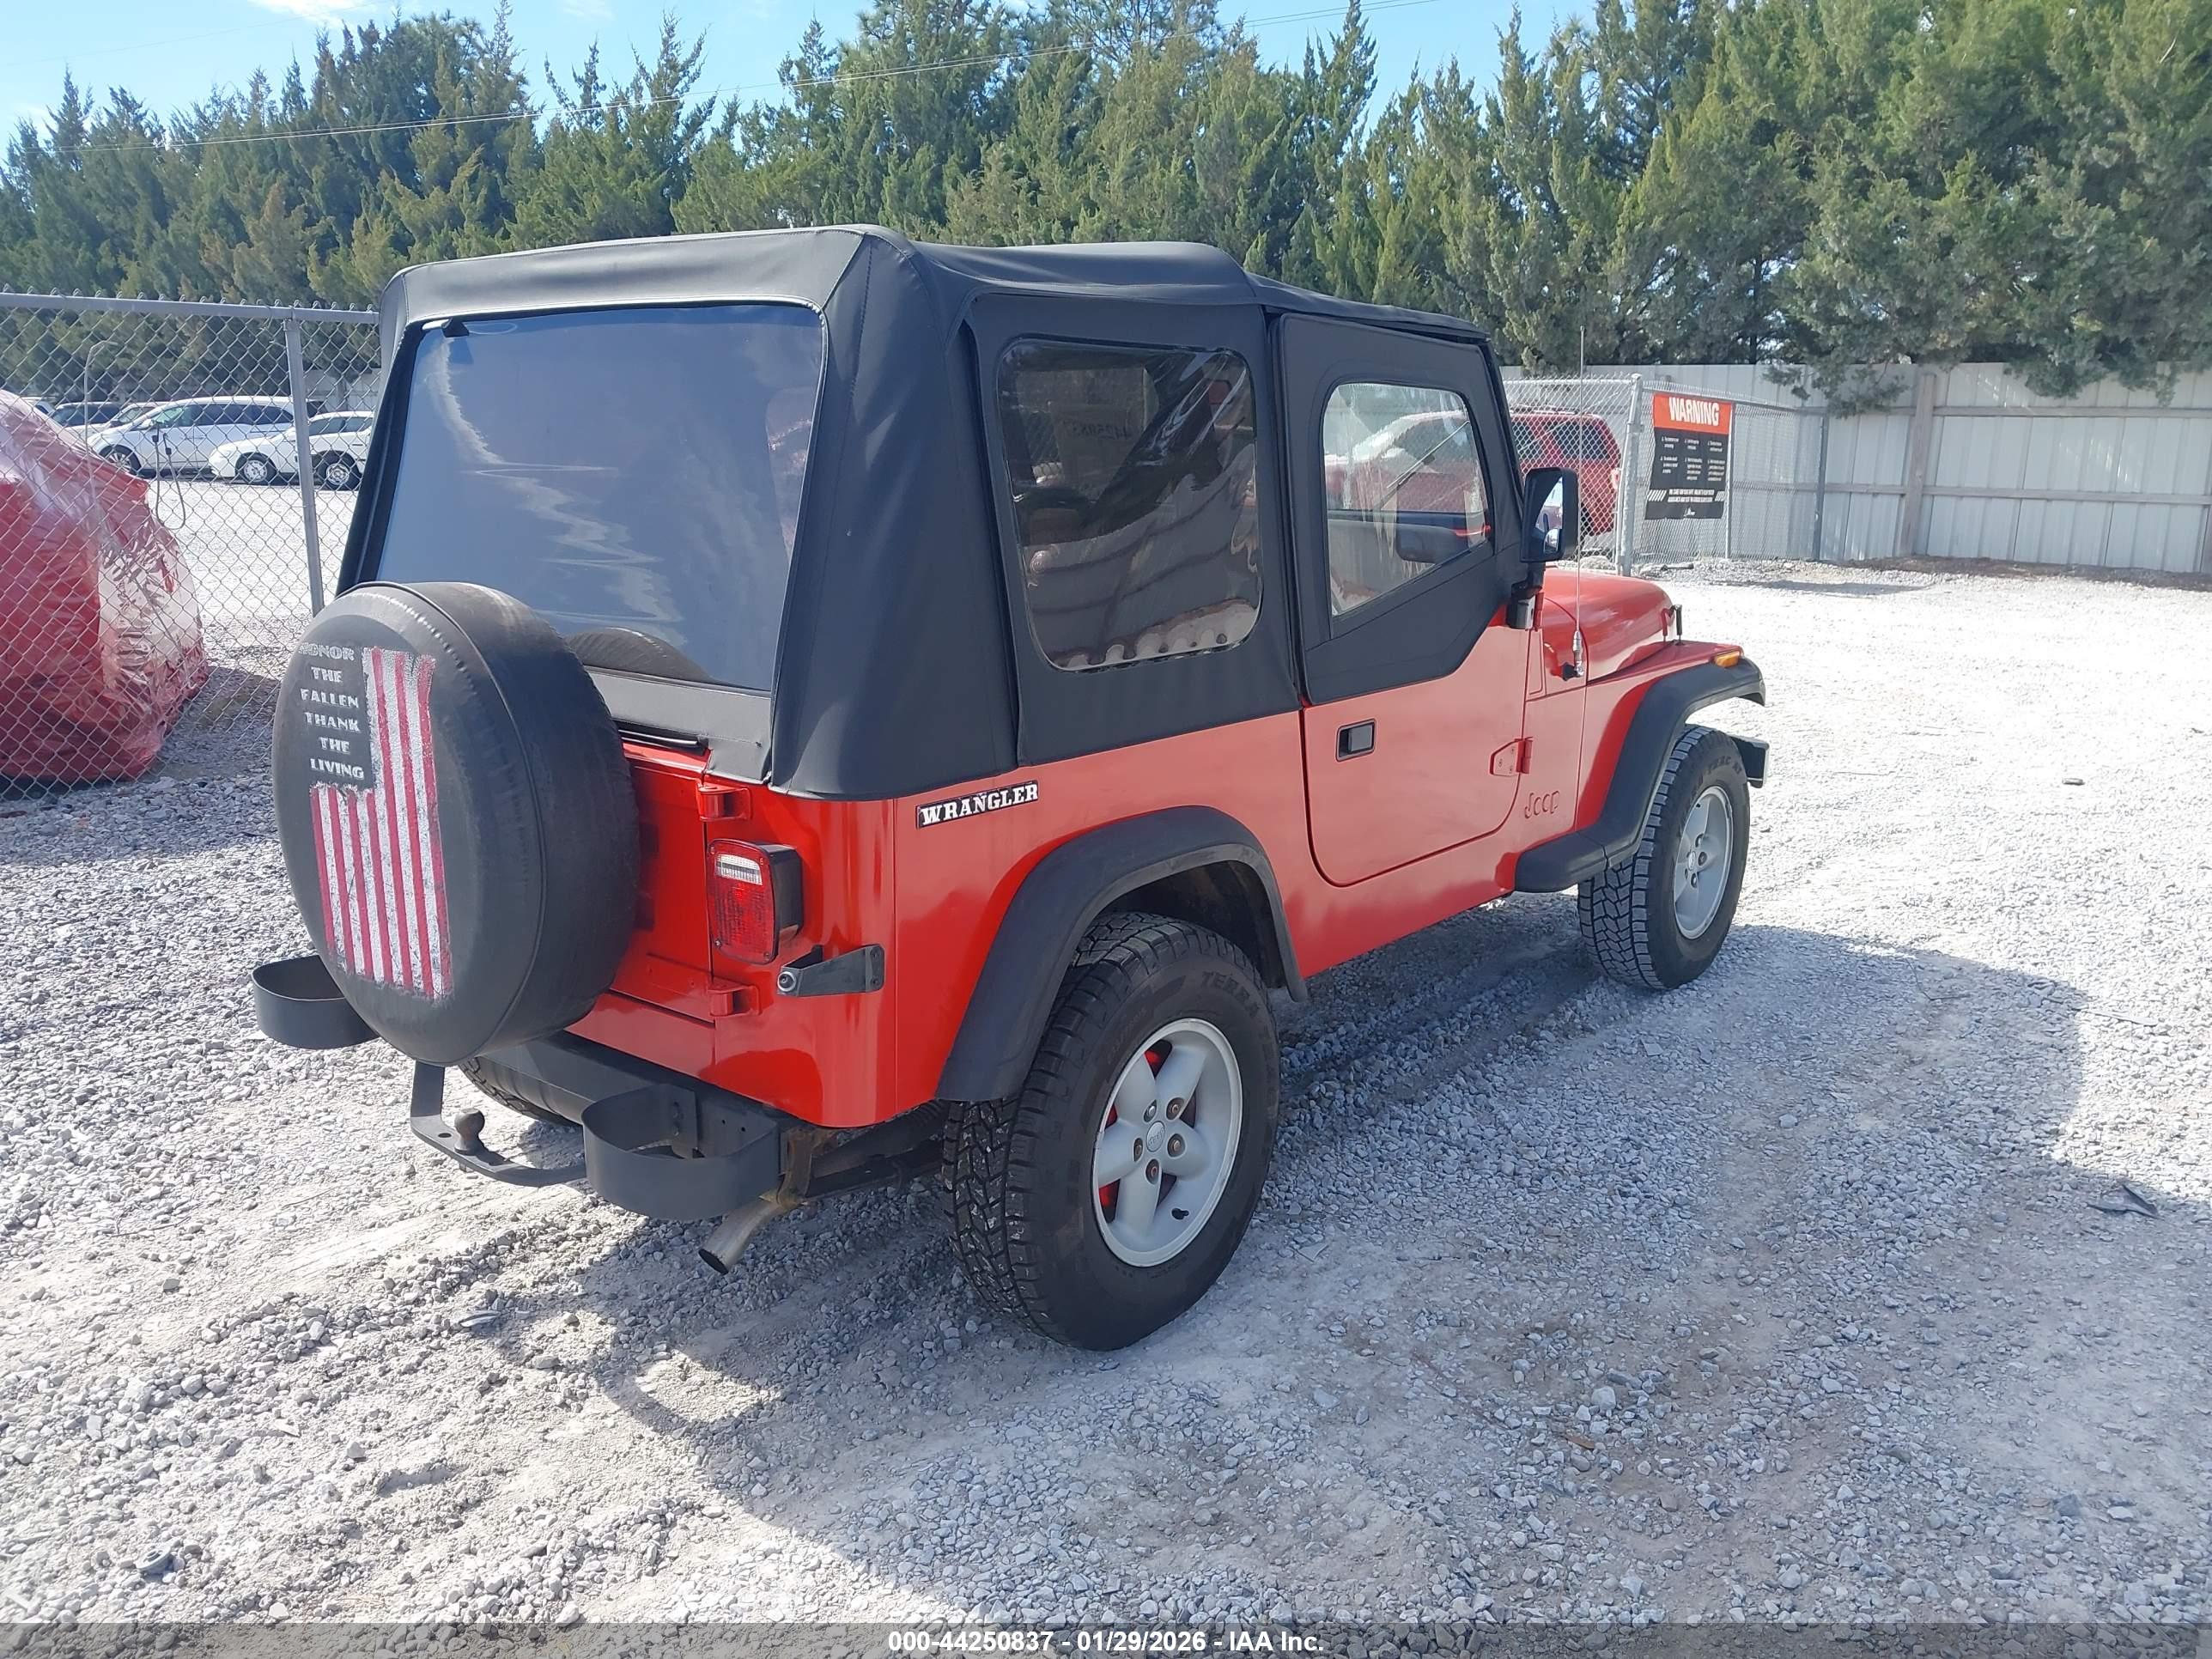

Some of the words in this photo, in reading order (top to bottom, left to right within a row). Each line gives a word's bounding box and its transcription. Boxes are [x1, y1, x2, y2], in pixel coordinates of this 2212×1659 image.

[1668, 396, 1720, 427] WARNING
[311, 665, 343, 684] THE
[300, 688, 359, 708] FALLEN
[304, 711, 361, 733] THANK
[319, 736, 350, 755] THE
[310, 758, 365, 780] LIVING
[919, 782, 1039, 826] WRANGLER
